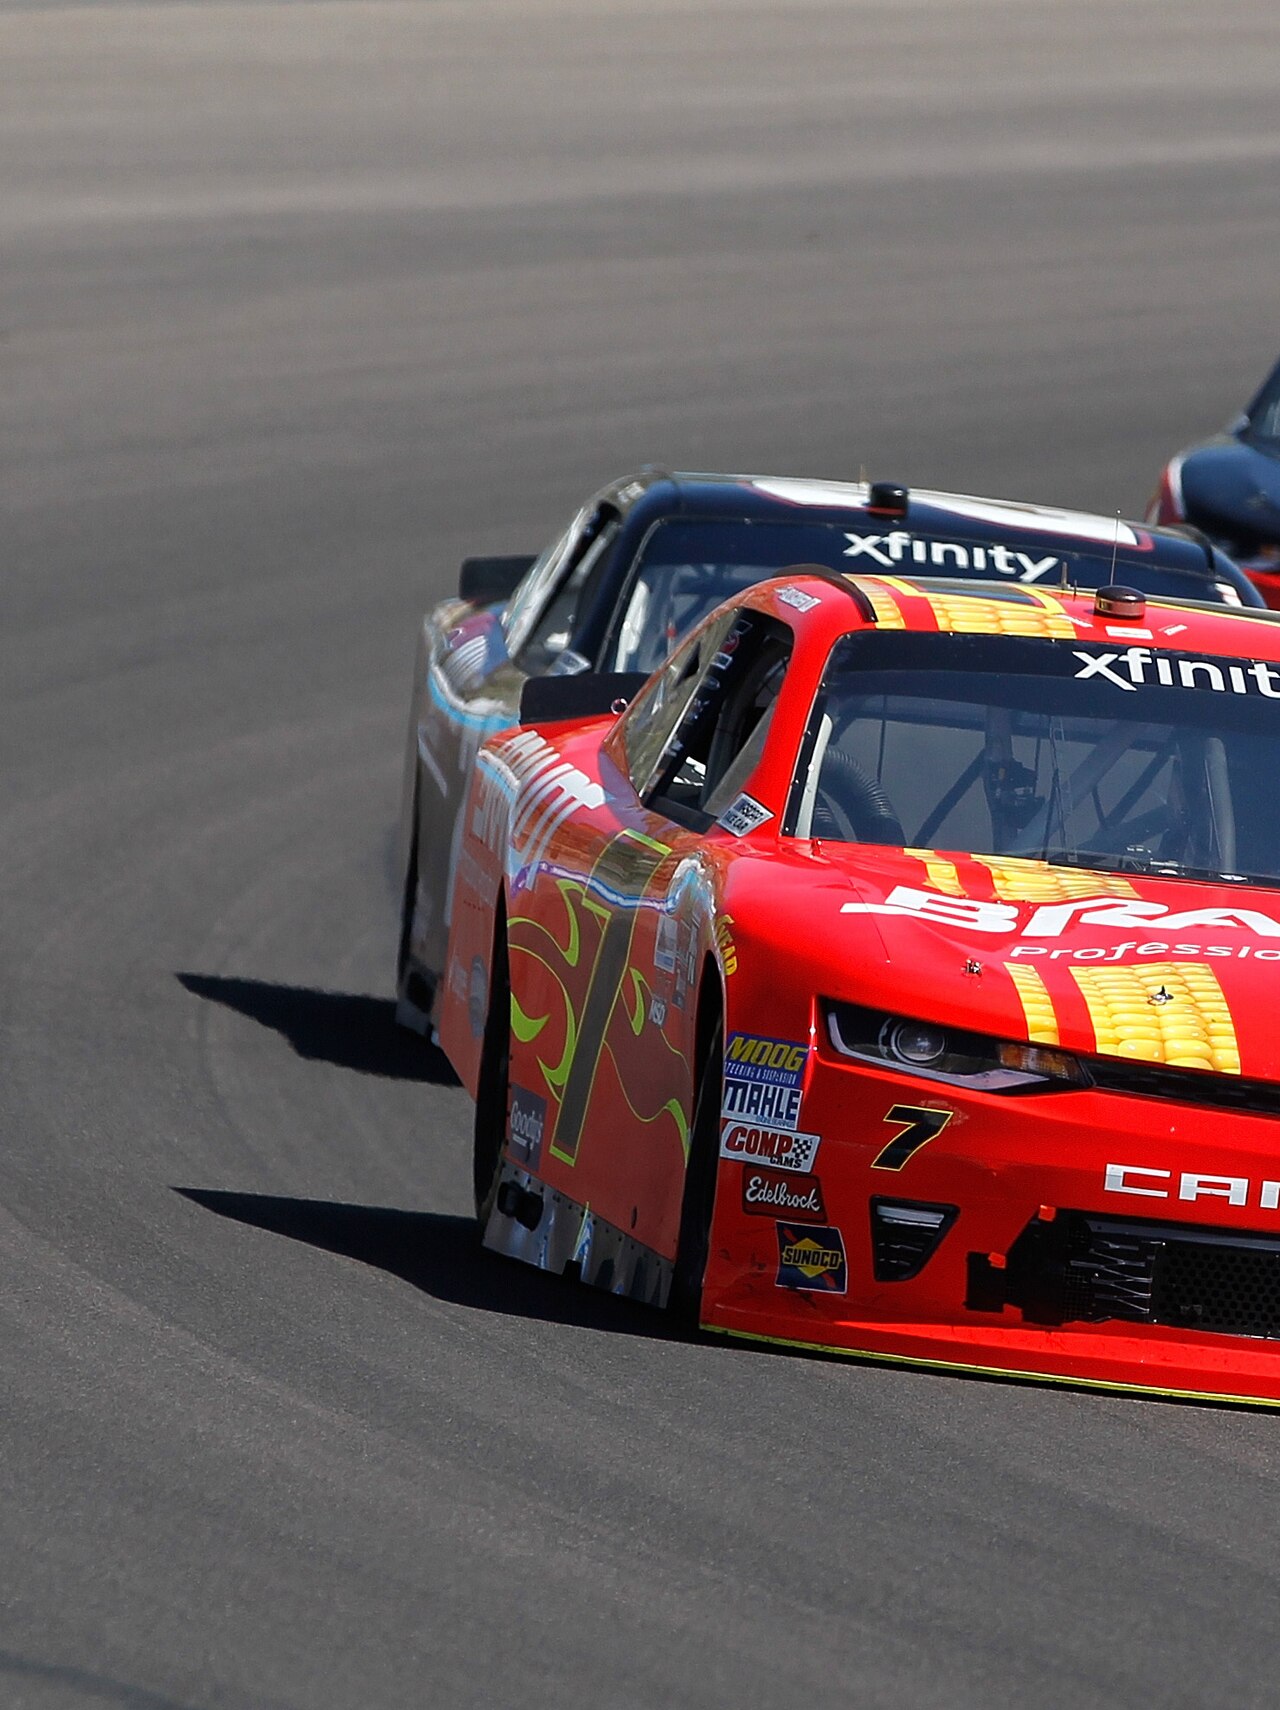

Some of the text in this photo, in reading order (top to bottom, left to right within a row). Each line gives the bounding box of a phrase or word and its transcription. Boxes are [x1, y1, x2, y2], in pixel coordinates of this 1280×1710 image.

[843, 531, 1059, 582] xfinity
[725, 1036, 809, 1072] MOOG
[724, 1079, 801, 1121] MAHLE
[725, 1126, 794, 1158] COMP
[870, 1104, 954, 1172] 7
[769, 1155, 803, 1169] CAMS
[746, 1175, 820, 1212] Edelbrock
[784, 1247, 841, 1269] SUNOCO
